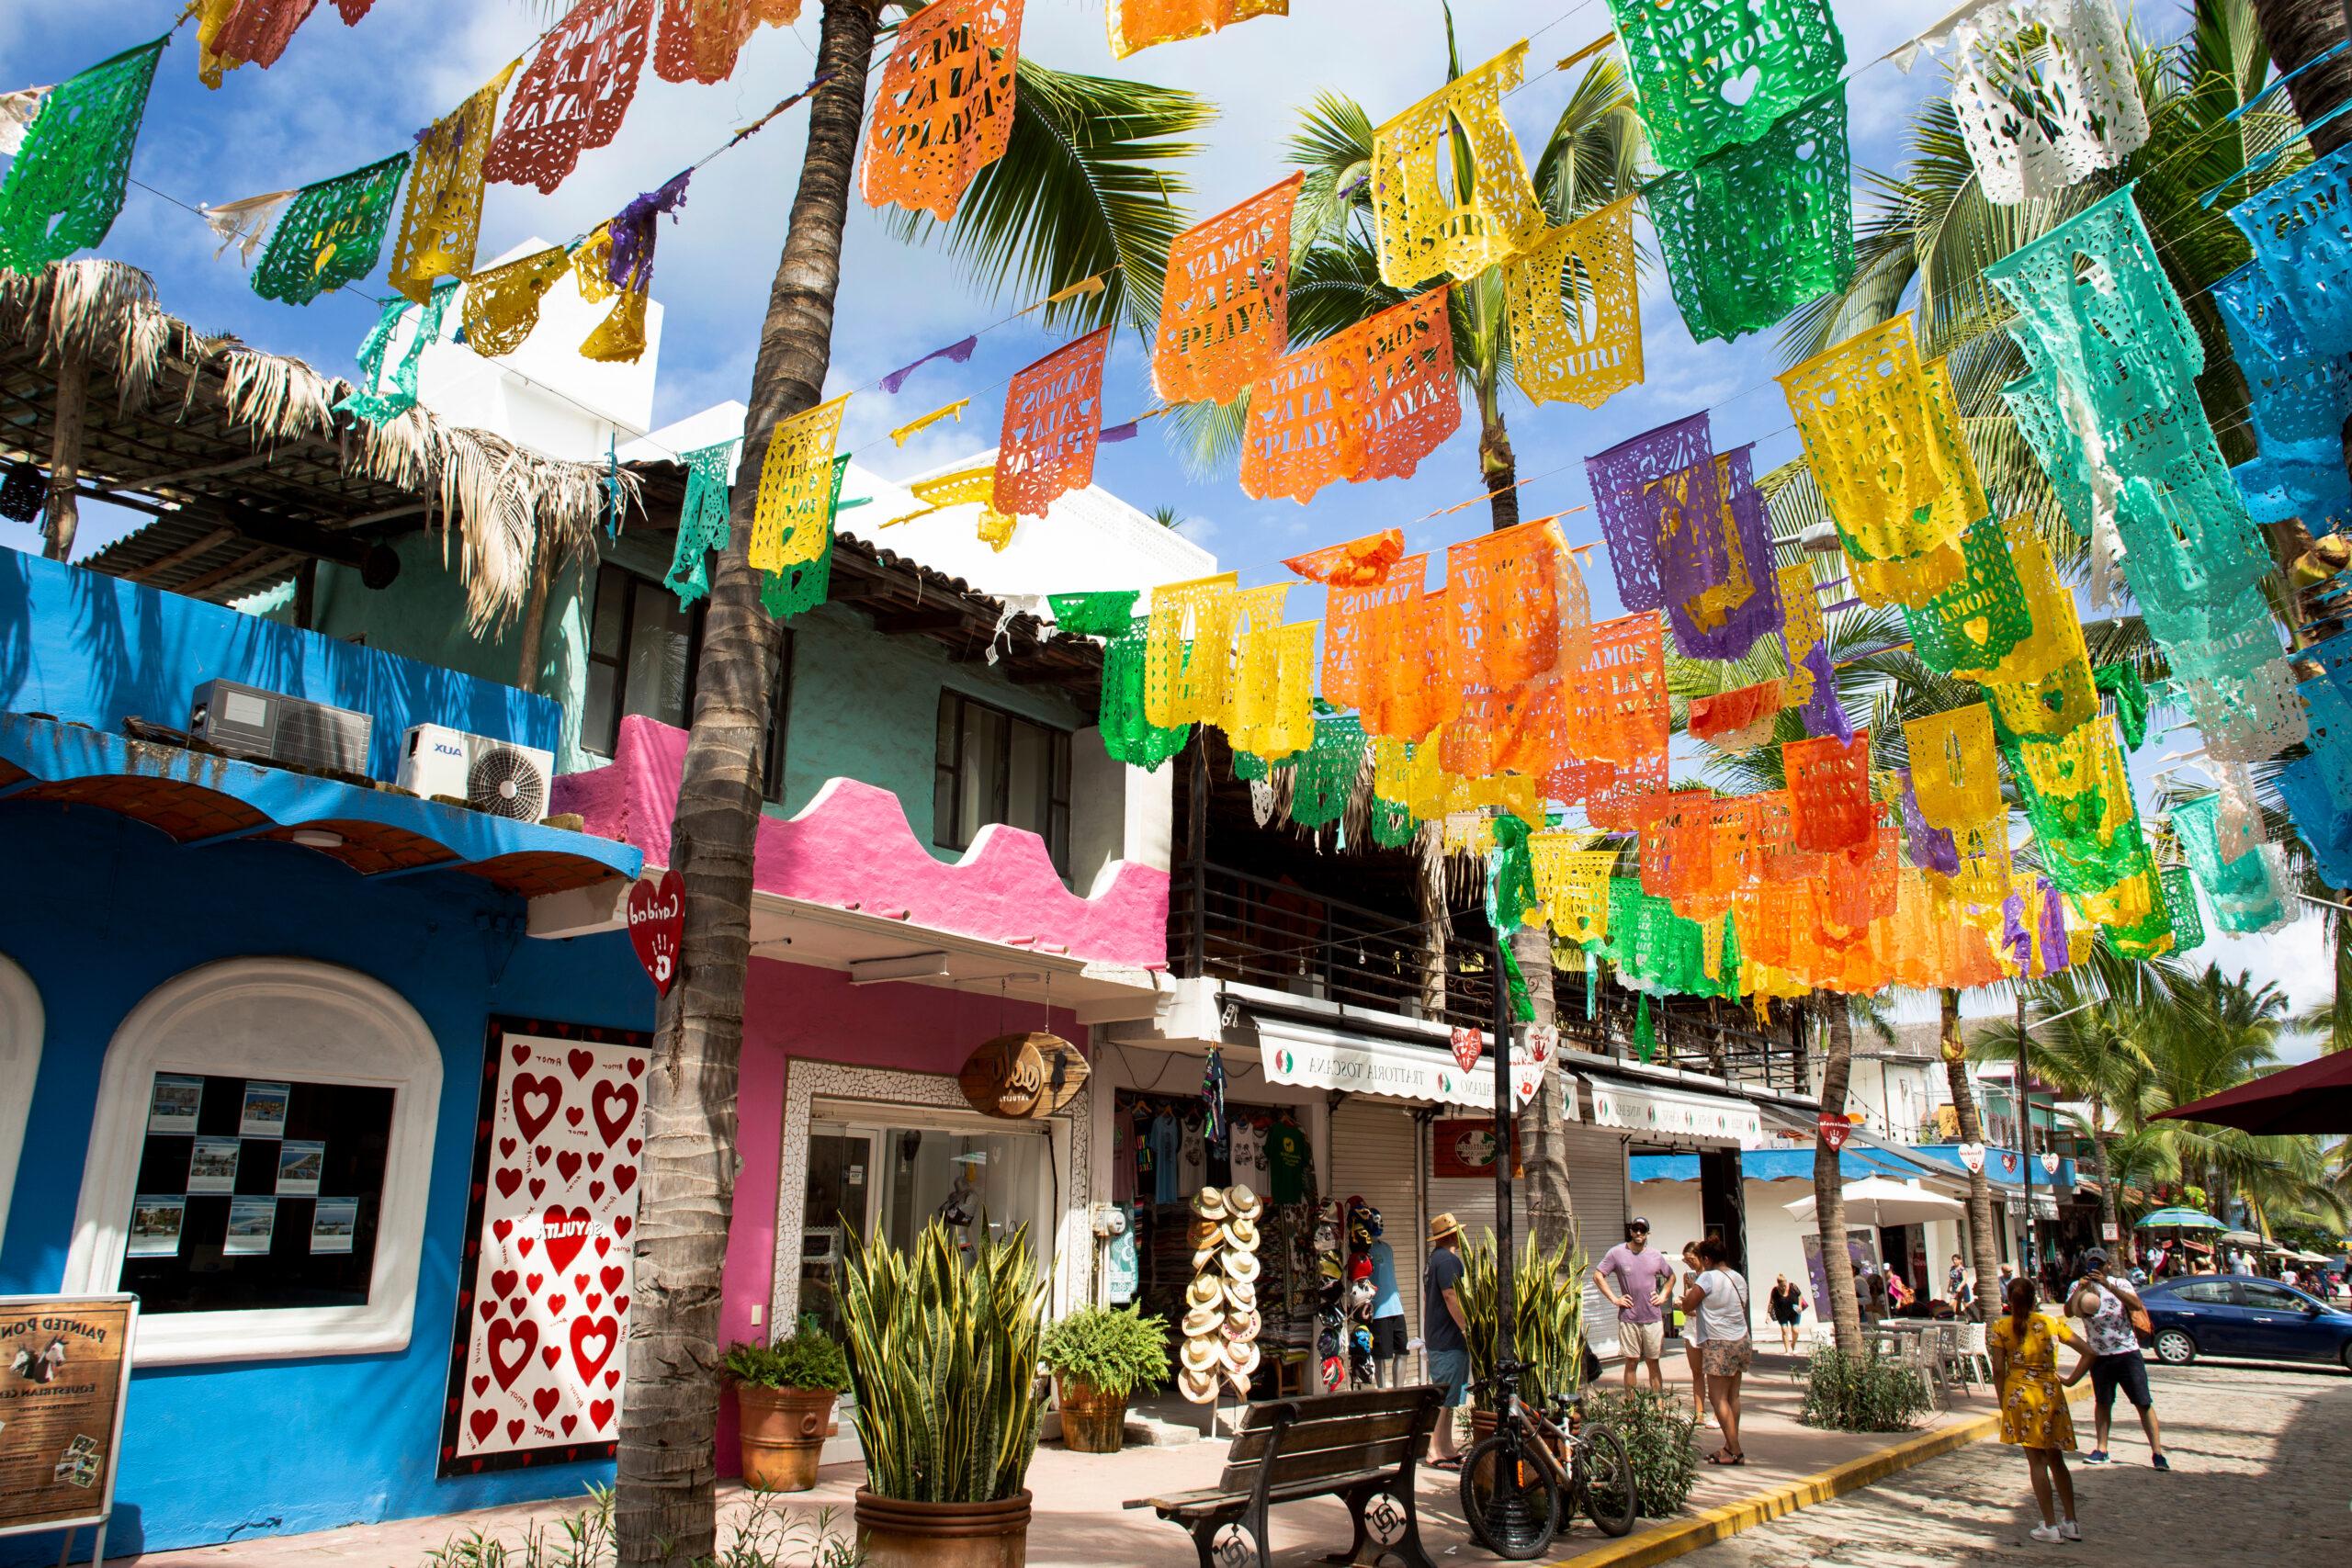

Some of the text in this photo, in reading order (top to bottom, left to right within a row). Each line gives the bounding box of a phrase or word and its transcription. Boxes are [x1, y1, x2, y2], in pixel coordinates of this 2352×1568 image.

[908, 2, 1007, 73] VAMOS
[917, 75, 939, 110] A
[893, 86, 996, 158] PLAYA
[1186, 217, 1277, 284] VAMOS
[1196, 266, 1260, 315] A LA
[1178, 296, 1275, 357] PLAYA
[1366, 320, 1430, 366] AMOS
[1270, 356, 1333, 397] VAMO
[1386, 354, 1418, 390] LA
[1548, 344, 1629, 380] SURF
[1278, 387, 1333, 424] A LA
[1938, 587, 1999, 623] AMOR
[1580, 639, 1648, 672] AMOS
